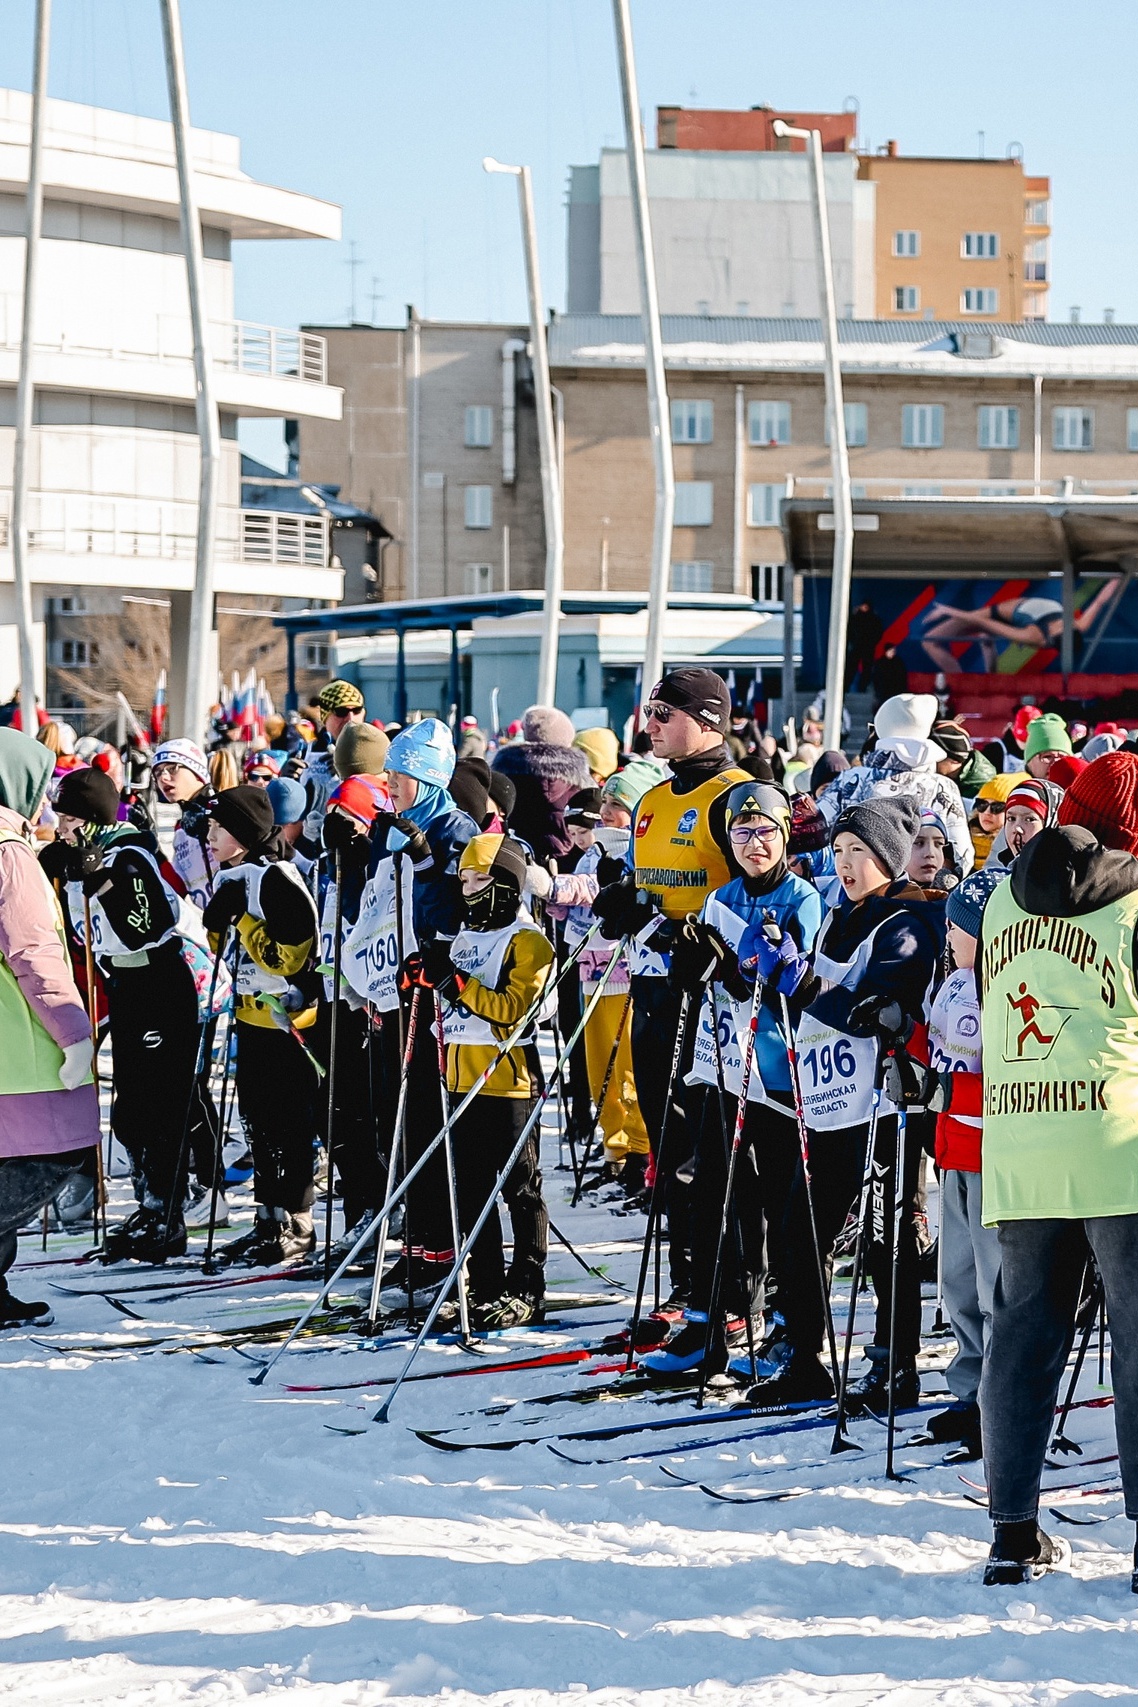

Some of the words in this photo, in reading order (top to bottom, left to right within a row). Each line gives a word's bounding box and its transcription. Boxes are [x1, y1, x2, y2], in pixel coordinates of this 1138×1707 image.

[810, 1100, 849, 1117] ОБЛАСТЬ
[984, 1076, 1109, 1117] ЧЕЛЯБИНСК
[872, 1182, 885, 1246] DEMIX
[750, 1403, 788, 1415] NORDWAY
